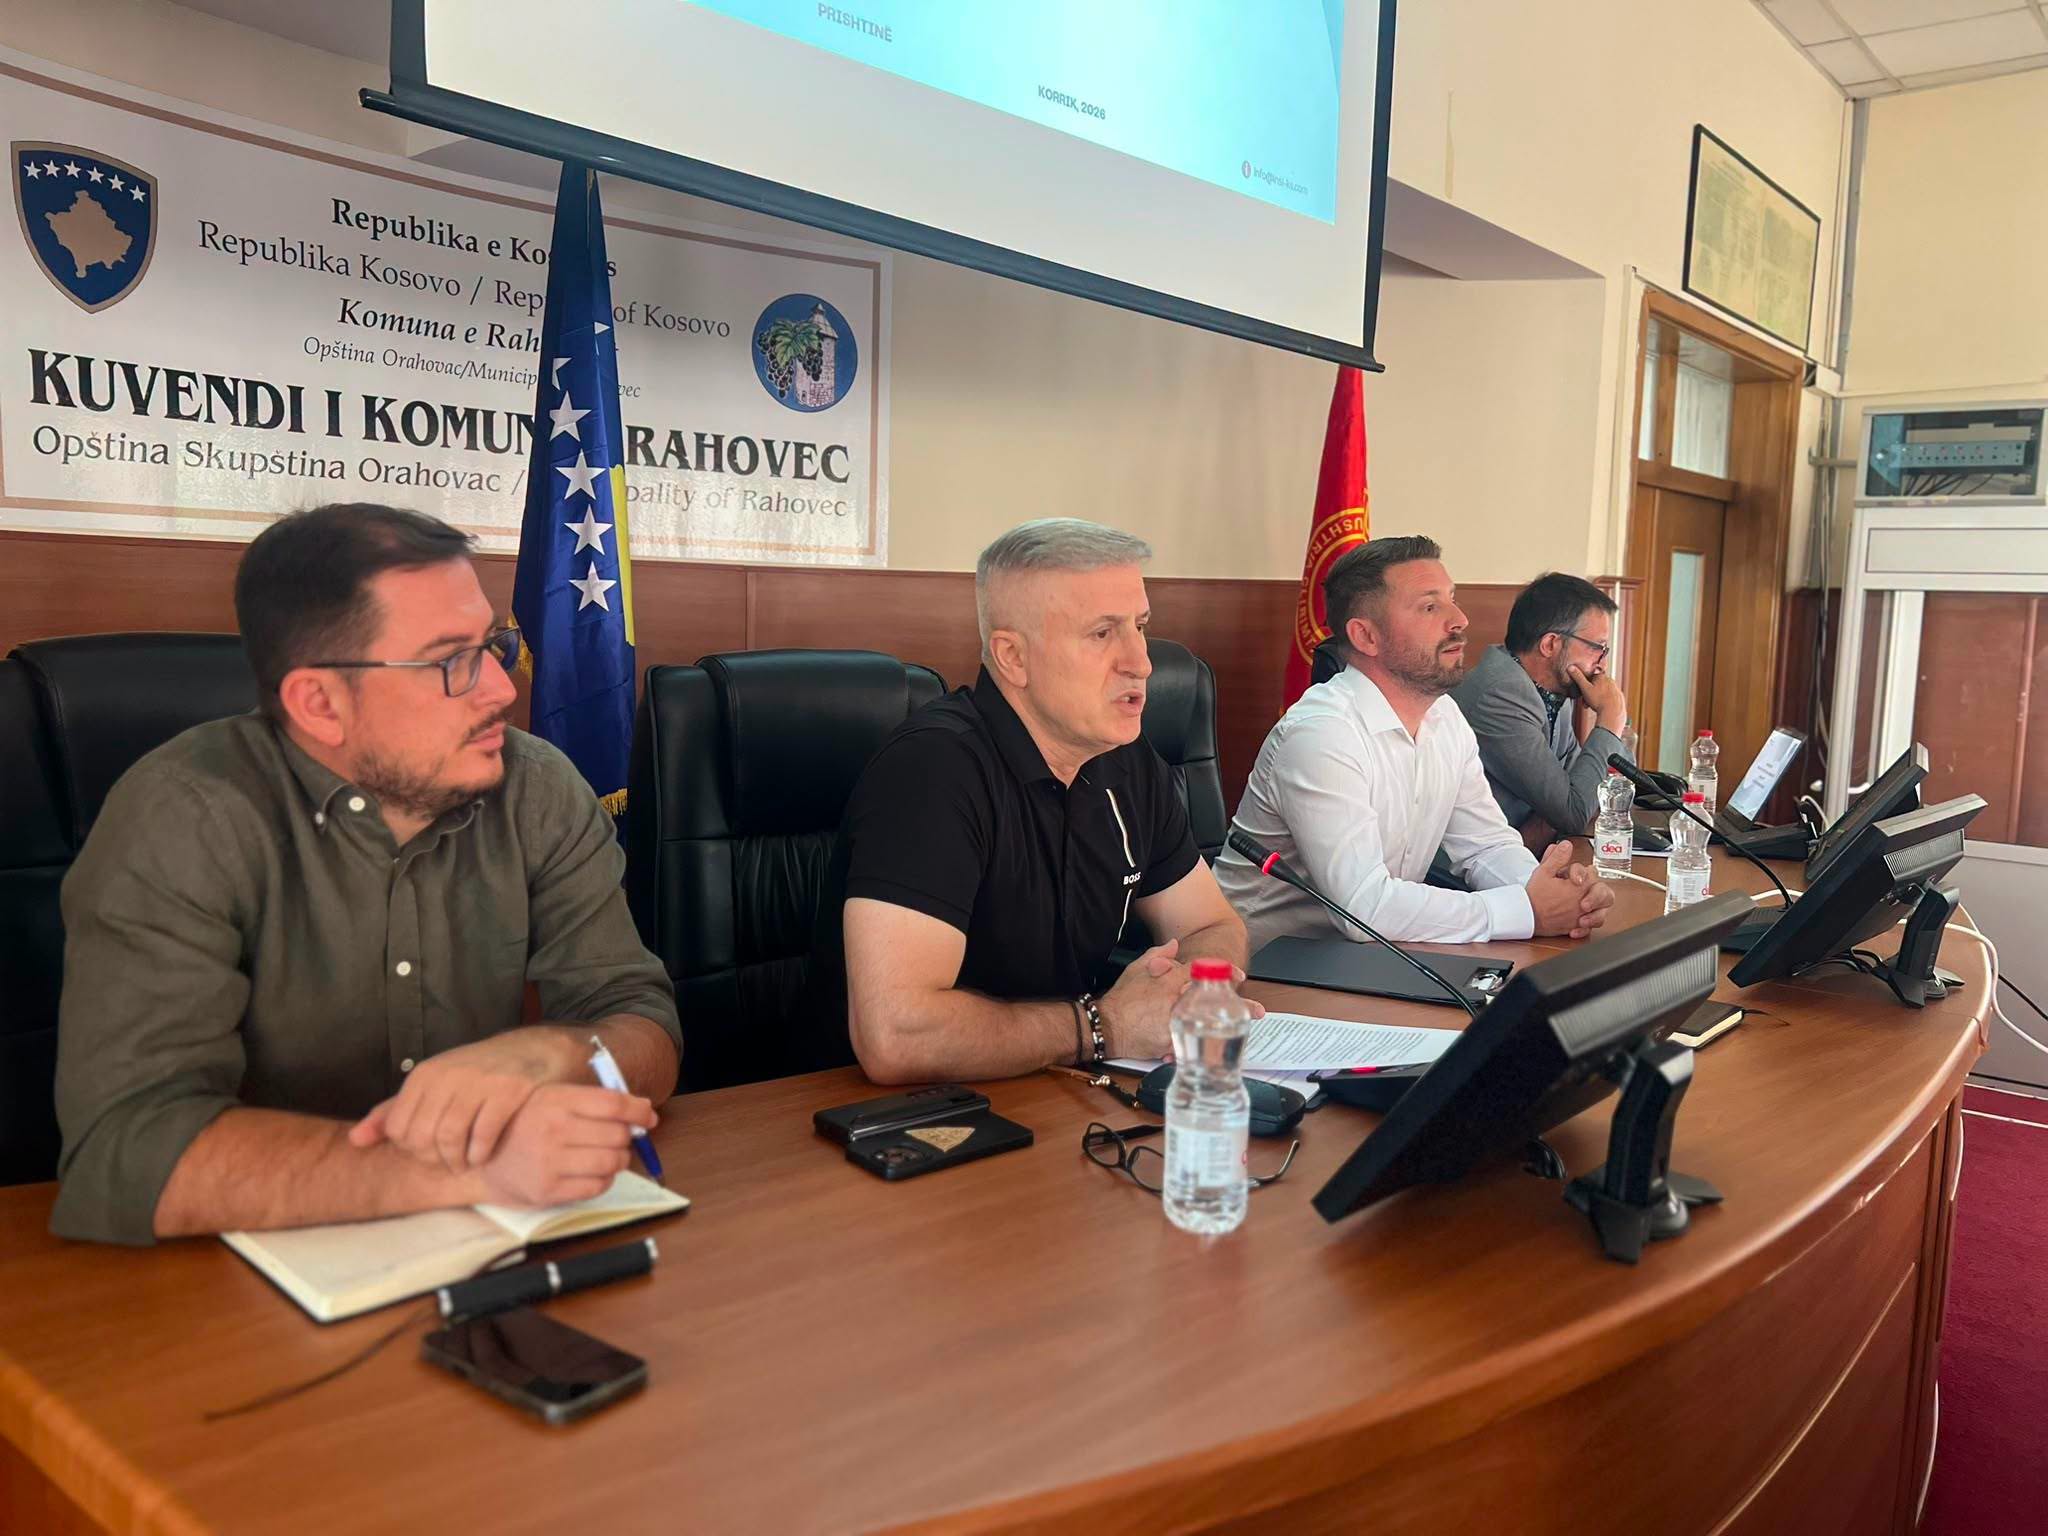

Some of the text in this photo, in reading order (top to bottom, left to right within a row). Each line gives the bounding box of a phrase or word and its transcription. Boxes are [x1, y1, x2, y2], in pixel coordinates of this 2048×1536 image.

[818, 2, 893, 43] PRISHTINË
[1081, 101, 1106, 120] 2026
[331, 198, 481, 255] Republika
[488, 240, 501, 258] e
[198, 220, 352, 277] Republika
[360, 254, 461, 297] Kosovo
[613, 301, 638, 325] of
[643, 304, 731, 338] Kosovo
[337, 298, 457, 342] Komuna
[464, 327, 478, 344] e
[303, 337, 375, 364] Opština
[28, 348, 307, 434] KUVENDI
[324, 390, 344, 438] I
[625, 425, 851, 485] RAHOVEC
[33, 426, 171, 466] Opština
[184, 440, 346, 481] Skupština
[359, 458, 501, 493] Orahovac
[706, 487, 736, 509] of
[741, 490, 848, 518] Rahovec
[1602, 842, 1622, 853] dea
